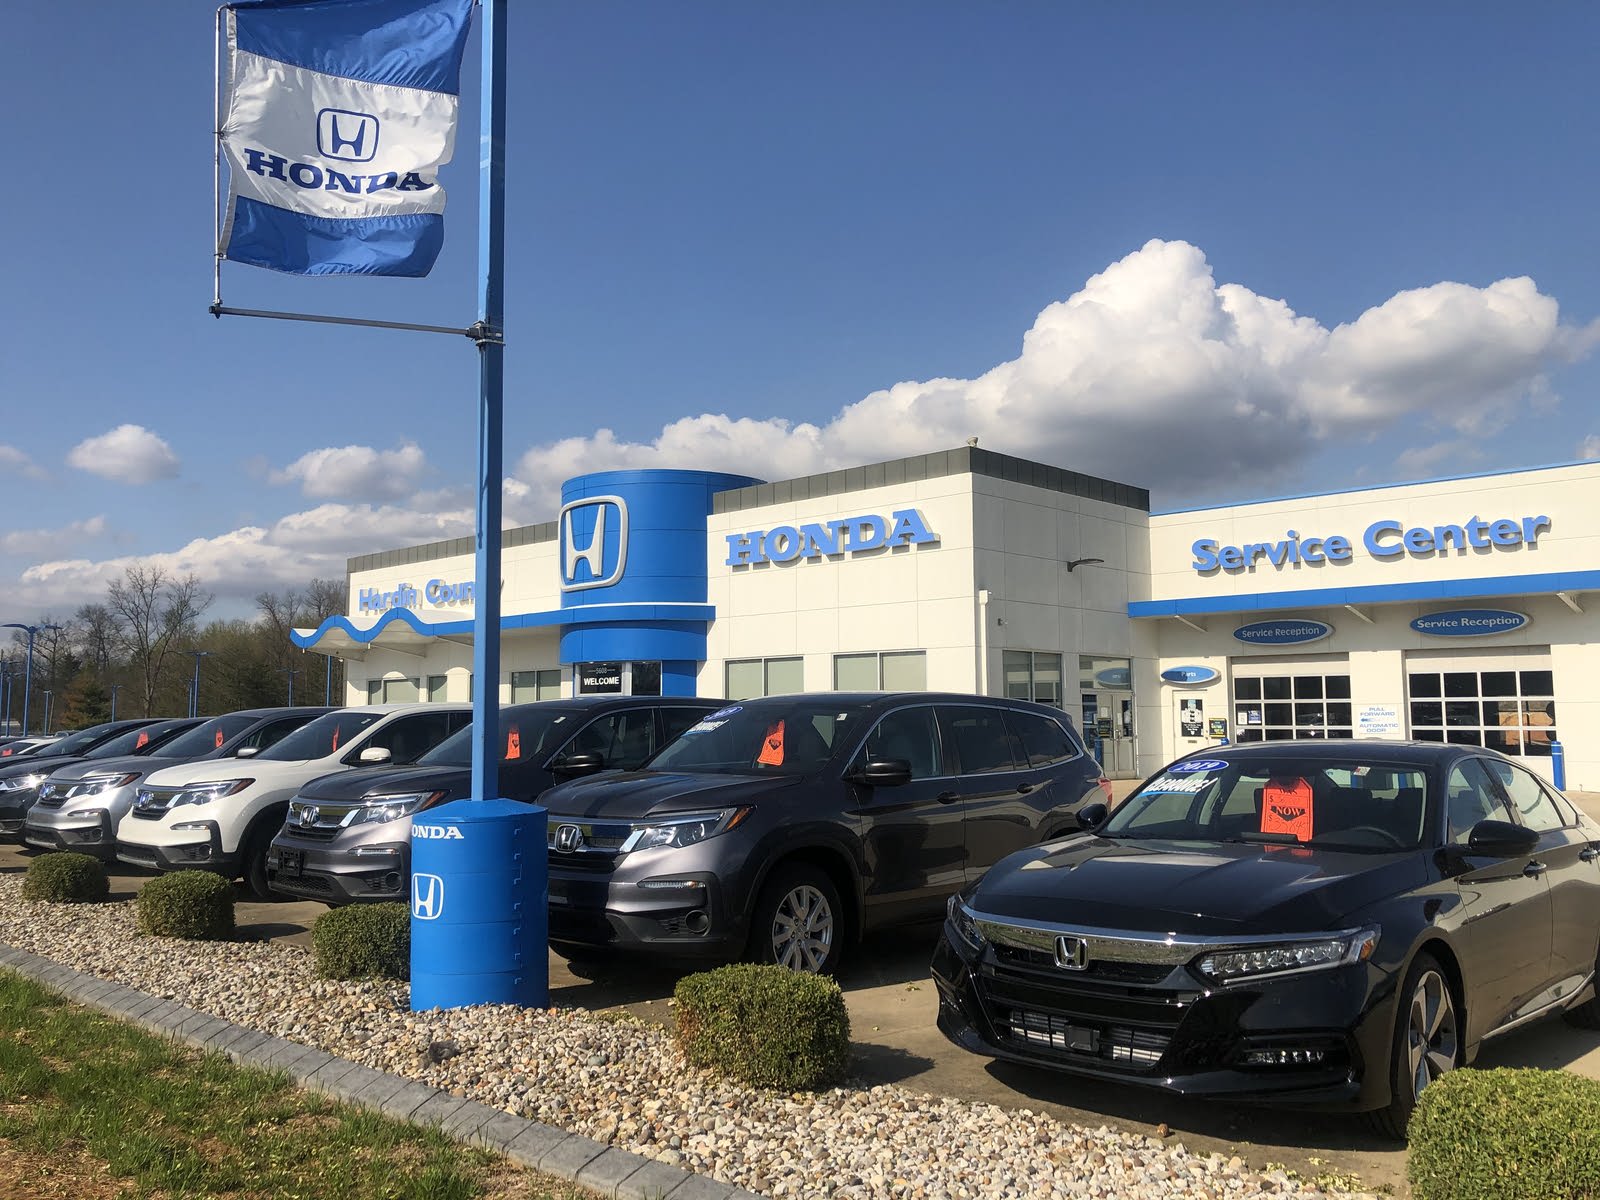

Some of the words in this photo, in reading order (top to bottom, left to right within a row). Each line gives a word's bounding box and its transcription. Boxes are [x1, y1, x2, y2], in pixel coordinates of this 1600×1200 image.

[244, 147, 434, 194] HONDA
[725, 508, 938, 566] HONDA
[1191, 529, 1353, 571] Service
[1363, 515, 1552, 556] Center
[359, 583, 418, 612] Hardin
[425, 578, 476, 605] Coun
[1417, 617, 1458, 629] Service
[1460, 615, 1521, 628] Reception
[1242, 628, 1273, 638] Service
[1275, 626, 1320, 637] Reception
[583, 676, 620, 686] WELCOME
[1174, 762, 1220, 771] 2019
[1275, 806, 1302, 816] NOW
[412, 825, 465, 840] ONDA
